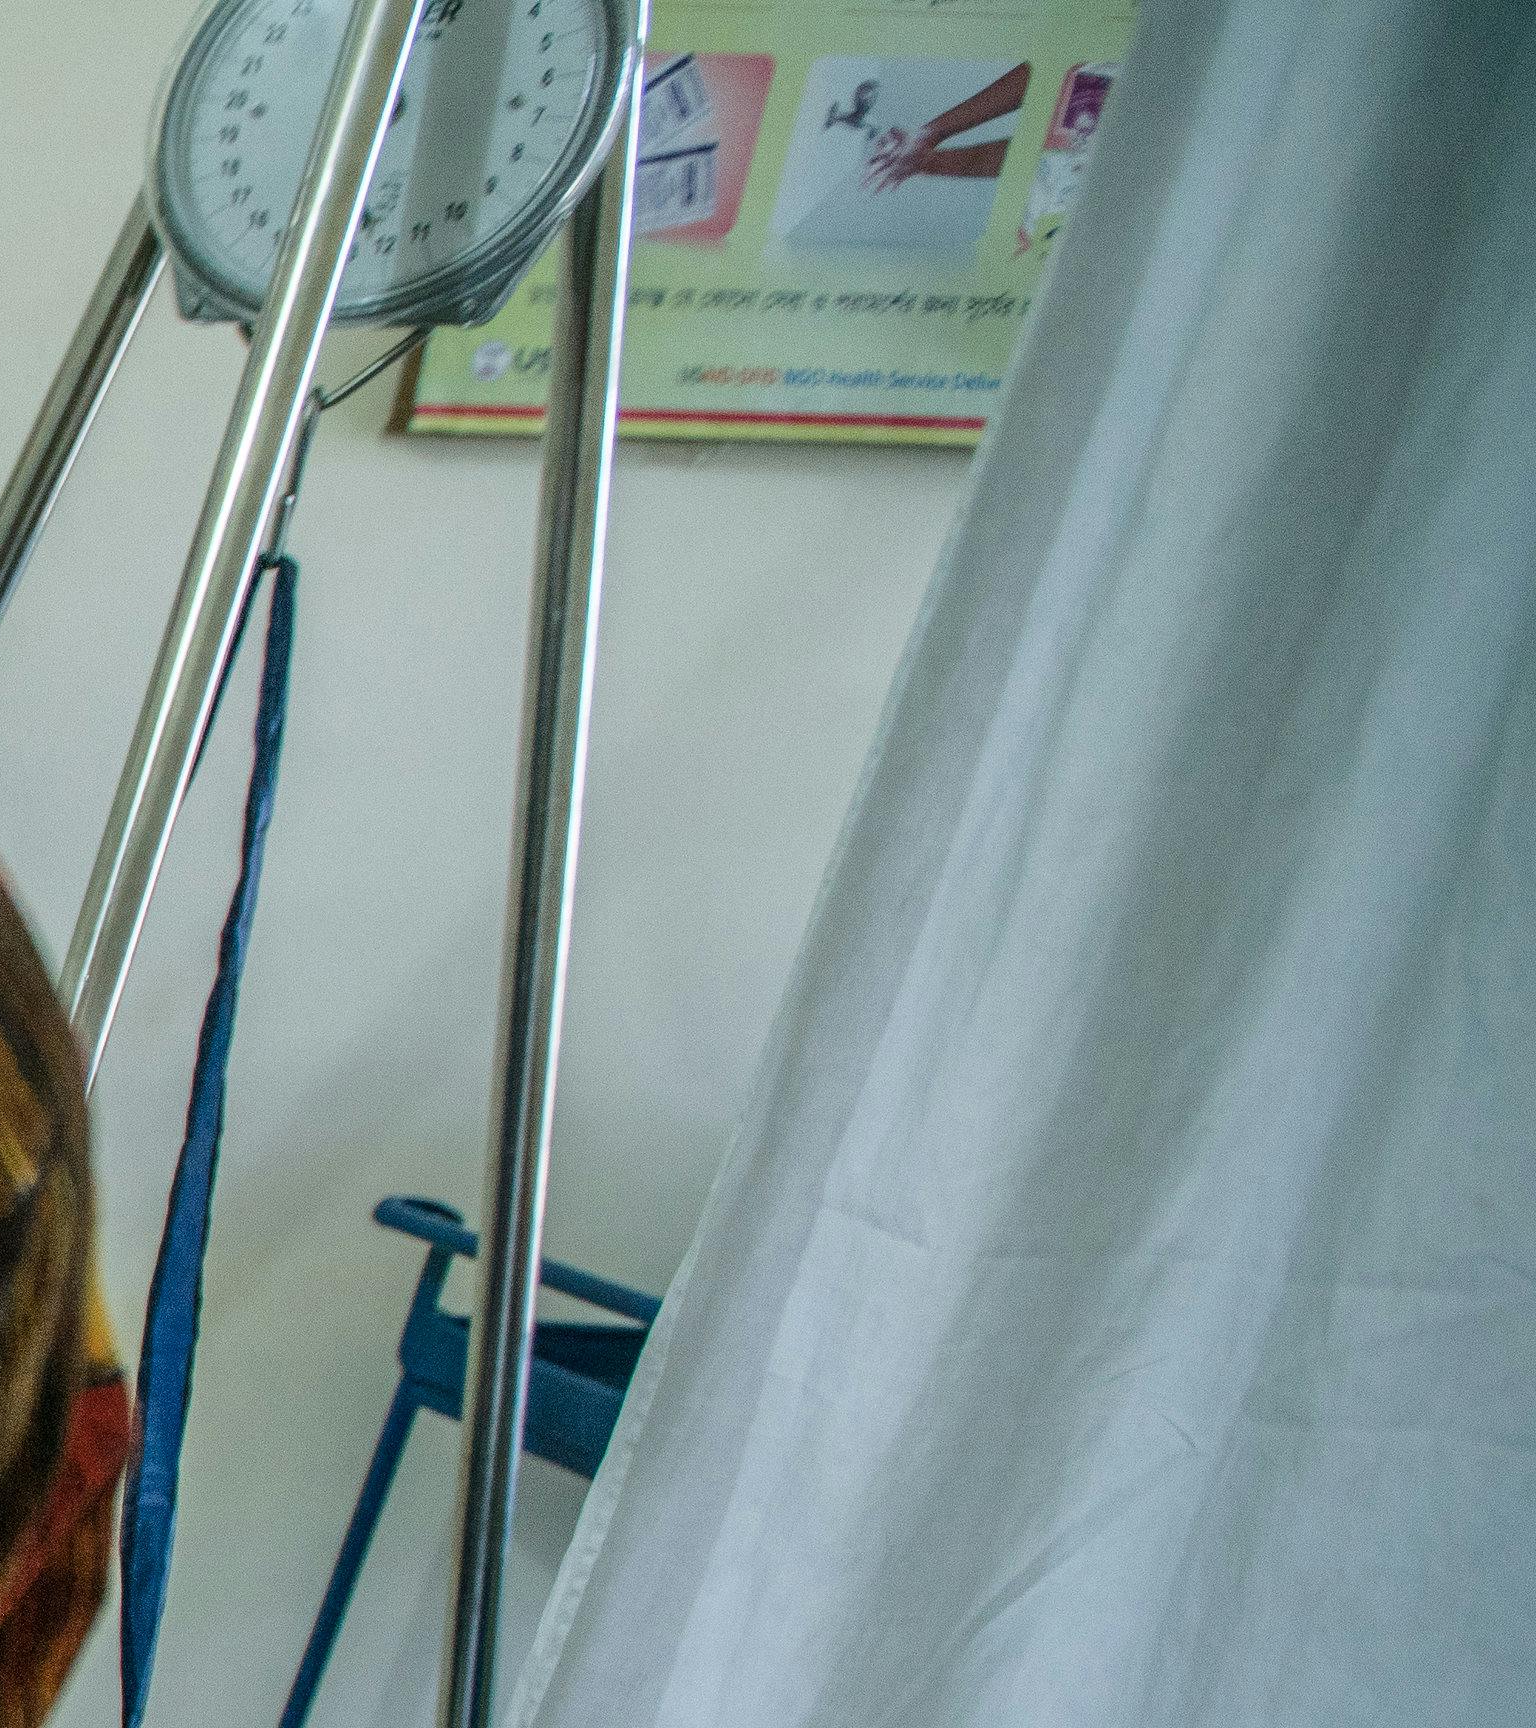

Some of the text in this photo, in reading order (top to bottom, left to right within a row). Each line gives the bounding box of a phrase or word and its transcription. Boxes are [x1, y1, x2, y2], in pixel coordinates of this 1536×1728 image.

[541, 67, 555, 87] 6
[219, 124, 239, 144] 19
[444, 199, 467, 221] 10
[411, 221, 431, 242] 11
[375, 235, 397, 255] 12
